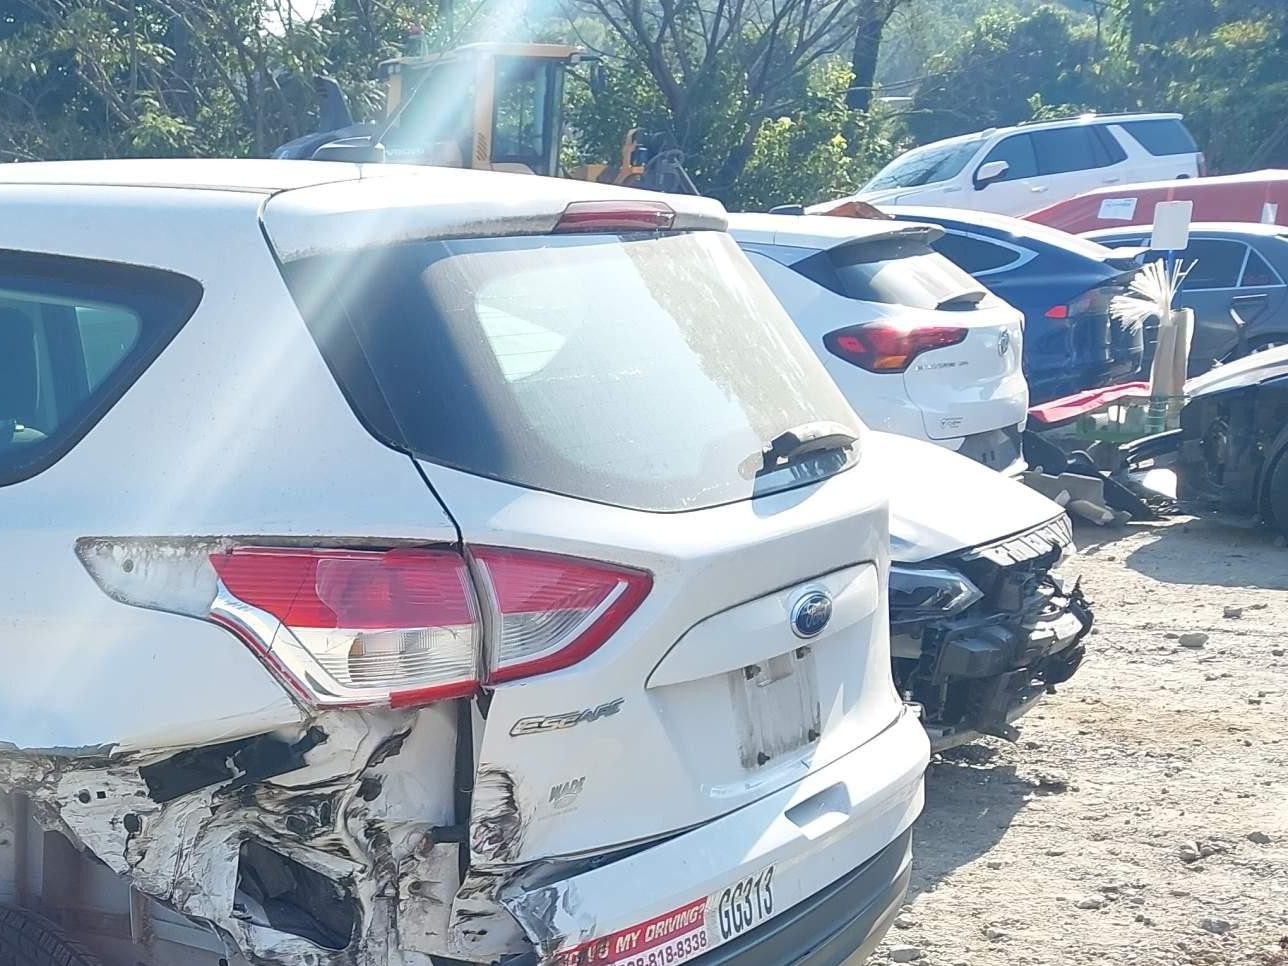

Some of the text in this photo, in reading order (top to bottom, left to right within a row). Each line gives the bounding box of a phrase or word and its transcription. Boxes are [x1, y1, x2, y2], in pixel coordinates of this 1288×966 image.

[615, 929, 642, 954] MY
[644, 902, 706, 943] DRIVING?
[718, 865, 775, 940] GG313
